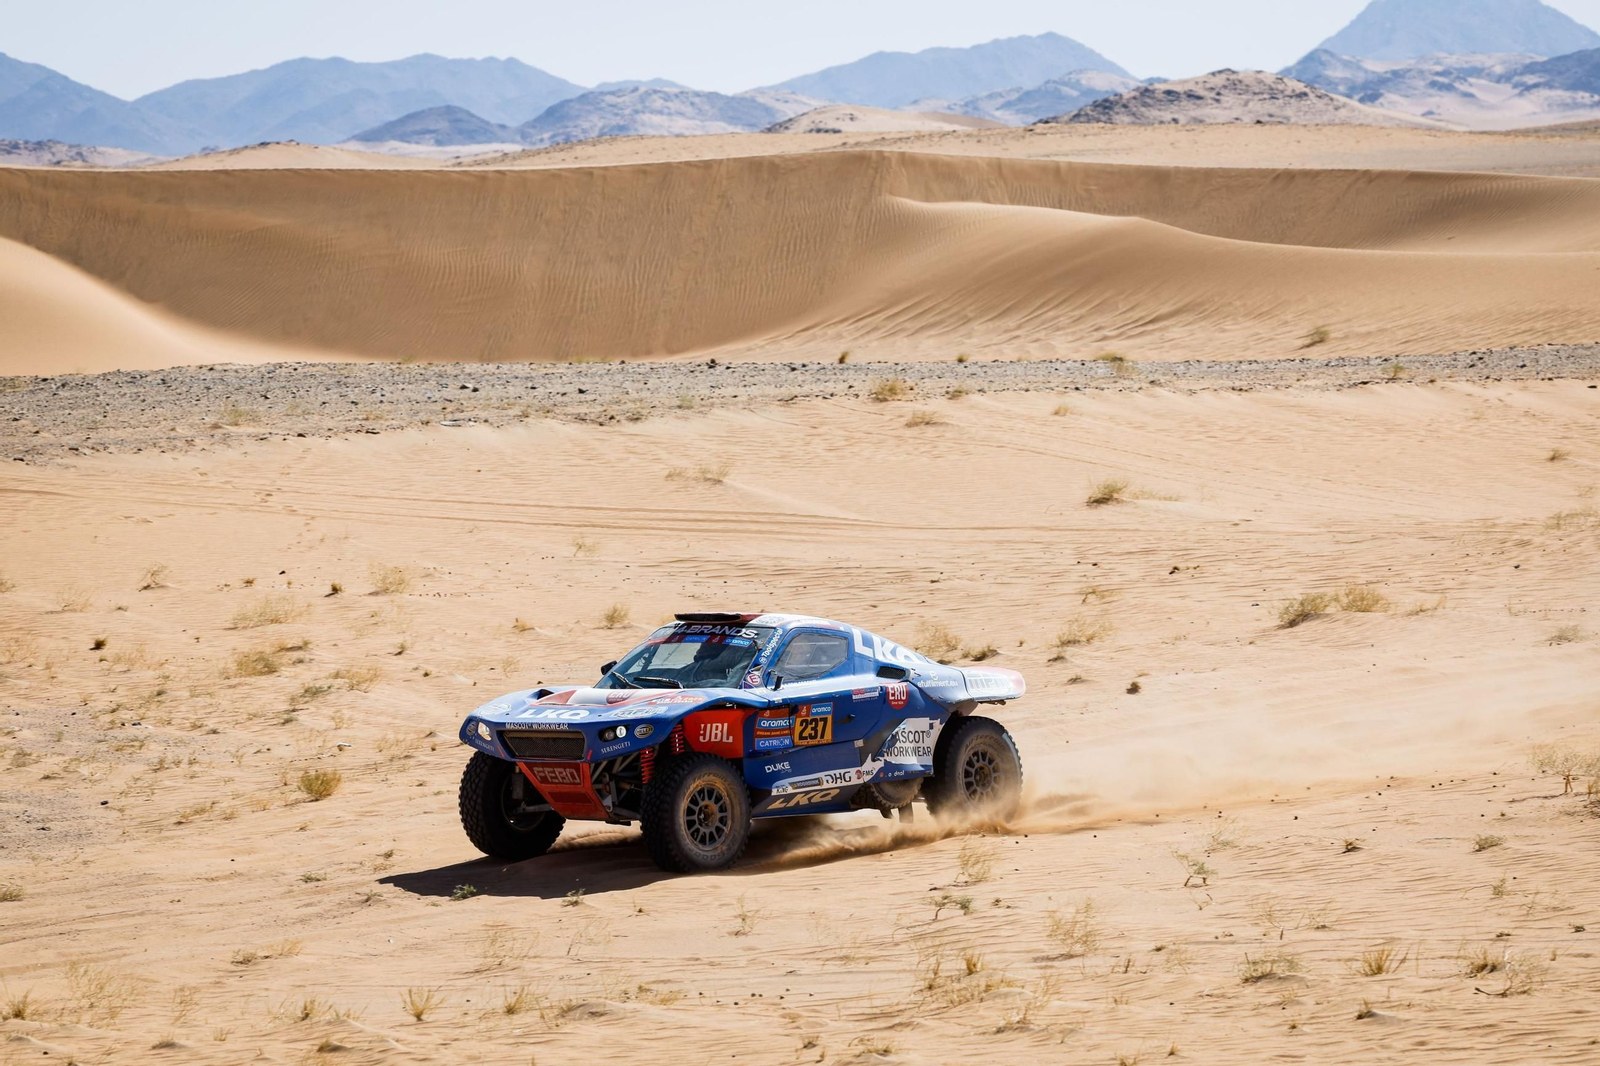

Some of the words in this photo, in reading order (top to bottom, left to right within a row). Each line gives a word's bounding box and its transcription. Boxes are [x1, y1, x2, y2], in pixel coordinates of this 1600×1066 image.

[761, 627, 784, 658] Toolspecial
[888, 685, 907, 700] ERU
[516, 709, 590, 720] LKQ
[532, 722, 569, 730] WORKWEAR
[761, 719, 792, 727] aramco
[799, 717, 828, 741] 237
[699, 722, 733, 743] JBL
[895, 729, 931, 744] ASCOT®
[601, 741, 631, 754] SERENGETI
[884, 746, 932, 757] WORKWEAR
[764, 761, 791, 773] DUKE
[532, 767, 581, 783] FEBO
[824, 770, 852, 785] DHG
[767, 788, 840, 809] LKQ
